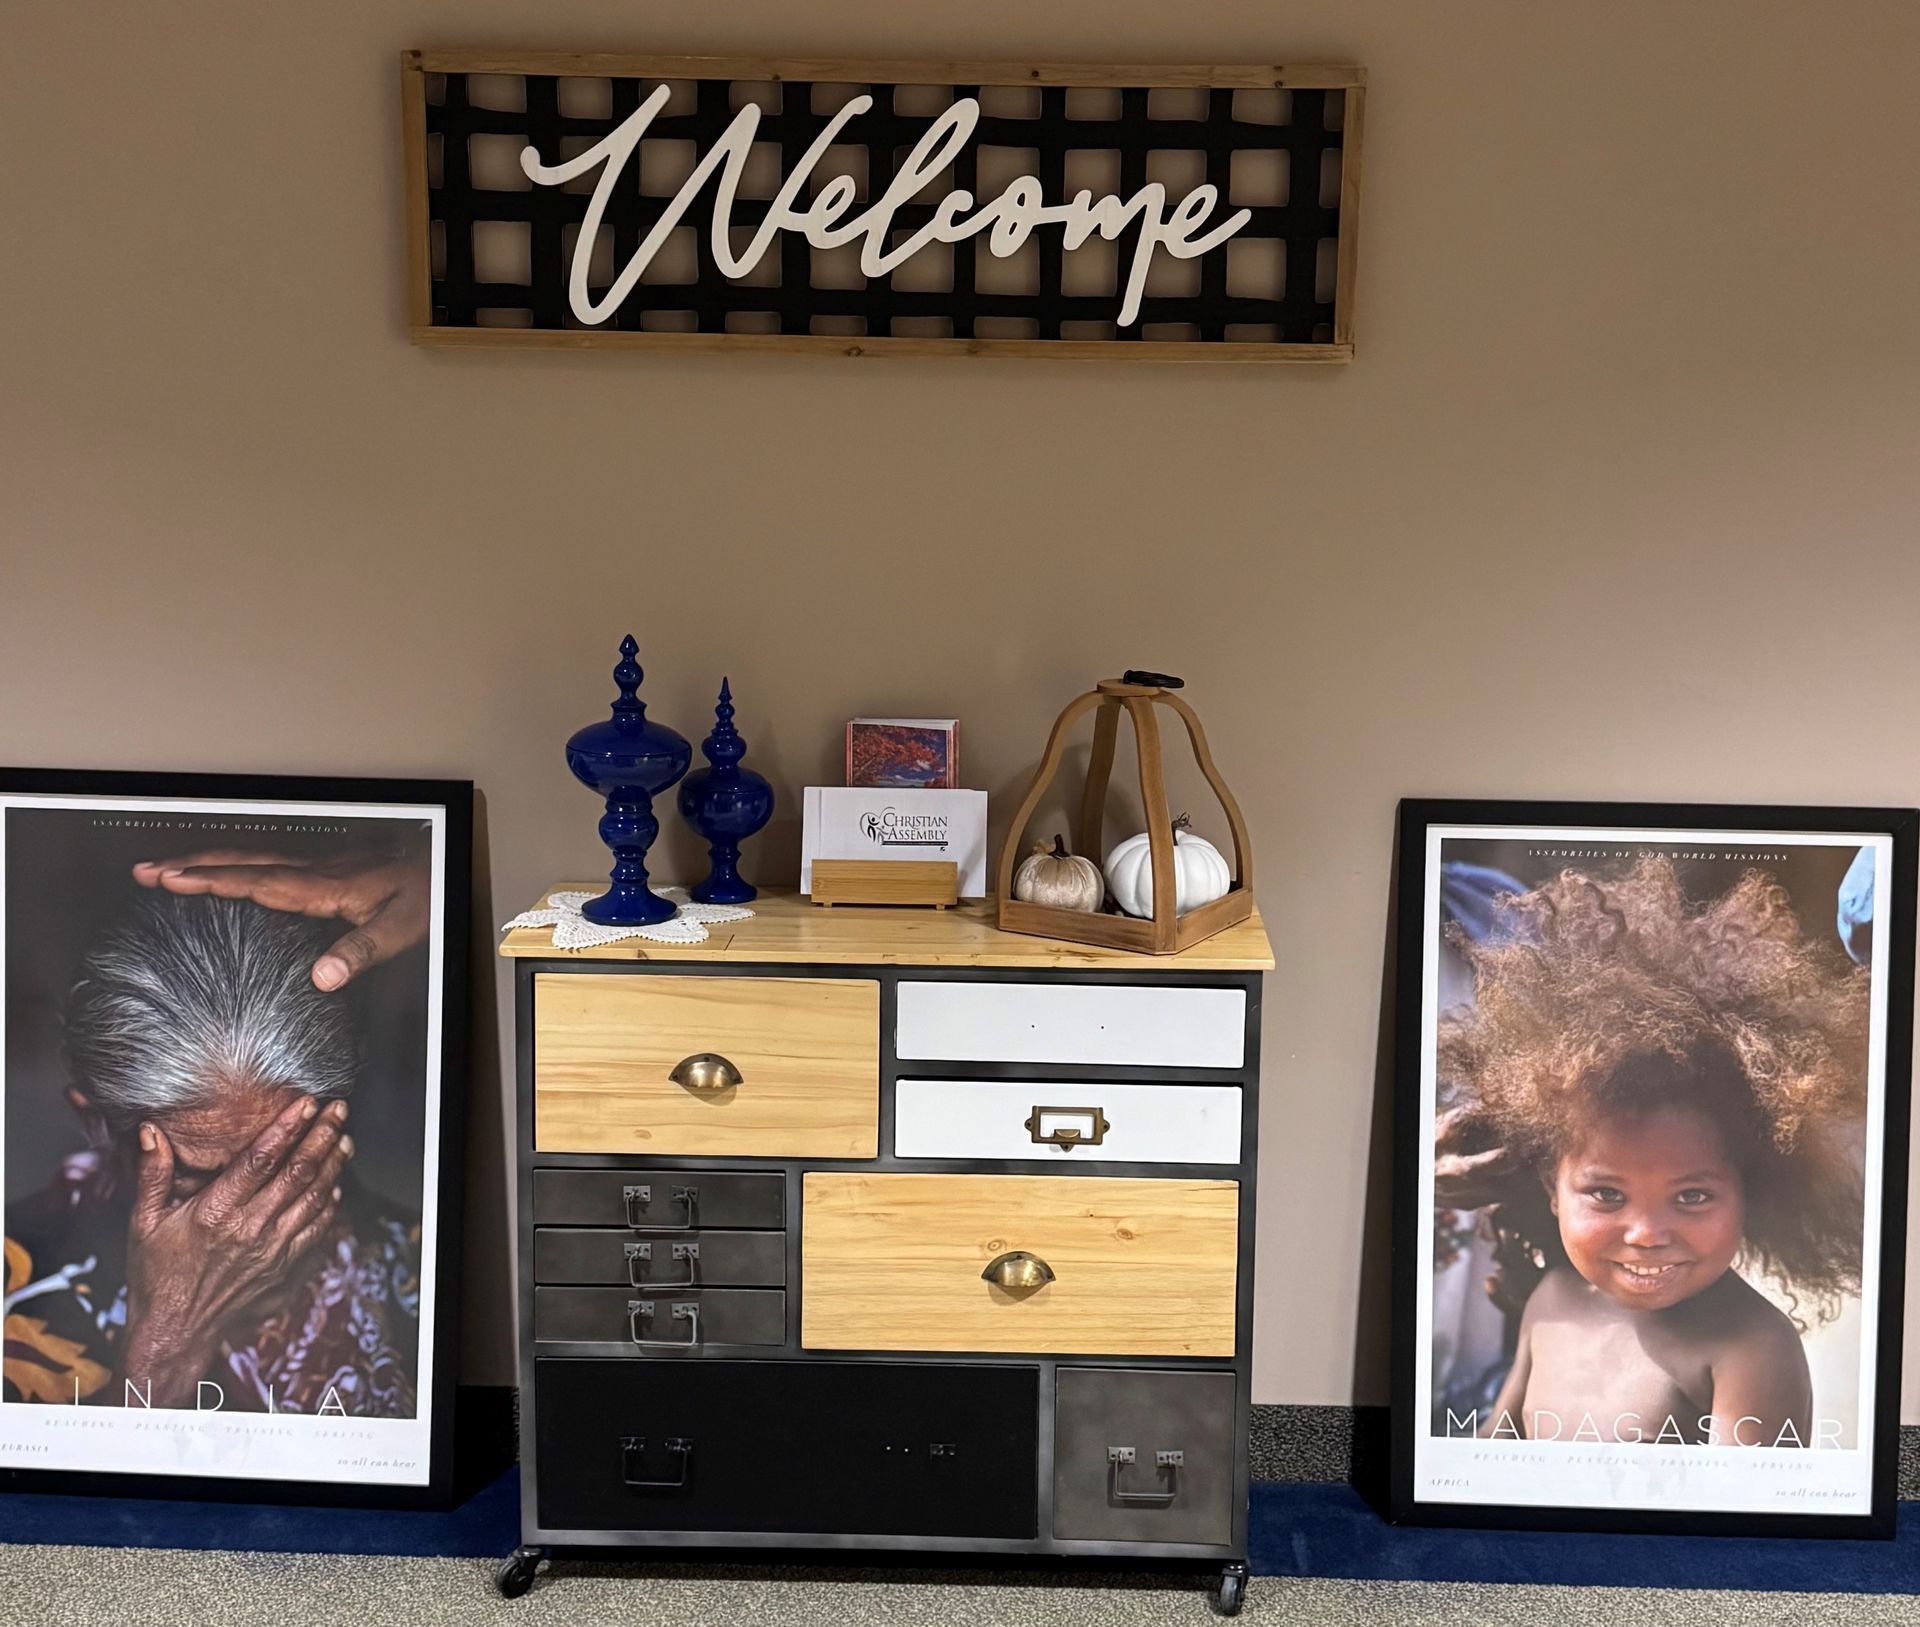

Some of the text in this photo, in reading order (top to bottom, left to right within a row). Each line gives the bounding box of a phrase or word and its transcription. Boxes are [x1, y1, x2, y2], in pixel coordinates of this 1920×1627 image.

[520, 84, 1251, 327] Welcome
[92, 819, 350, 834] ASSEMBLIES OF GOD WORLD MISSIONS
[883, 812, 948, 829] CHRISTIAN
[888, 827, 947, 840] ASSEMBLY
[1528, 849, 1790, 863] ASSEMBLIES OF GOD WORLD MISSIONS
[74, 1376, 348, 1417] INDIA
[1445, 1406, 1845, 1450] MADAGASCAR
[1, 1443, 49, 1453] EURASIA
[337, 1456, 417, 1468] so all can hear
[1428, 1478, 1471, 1488] AFRICA
[1775, 1487, 1858, 1499] so all can hear
